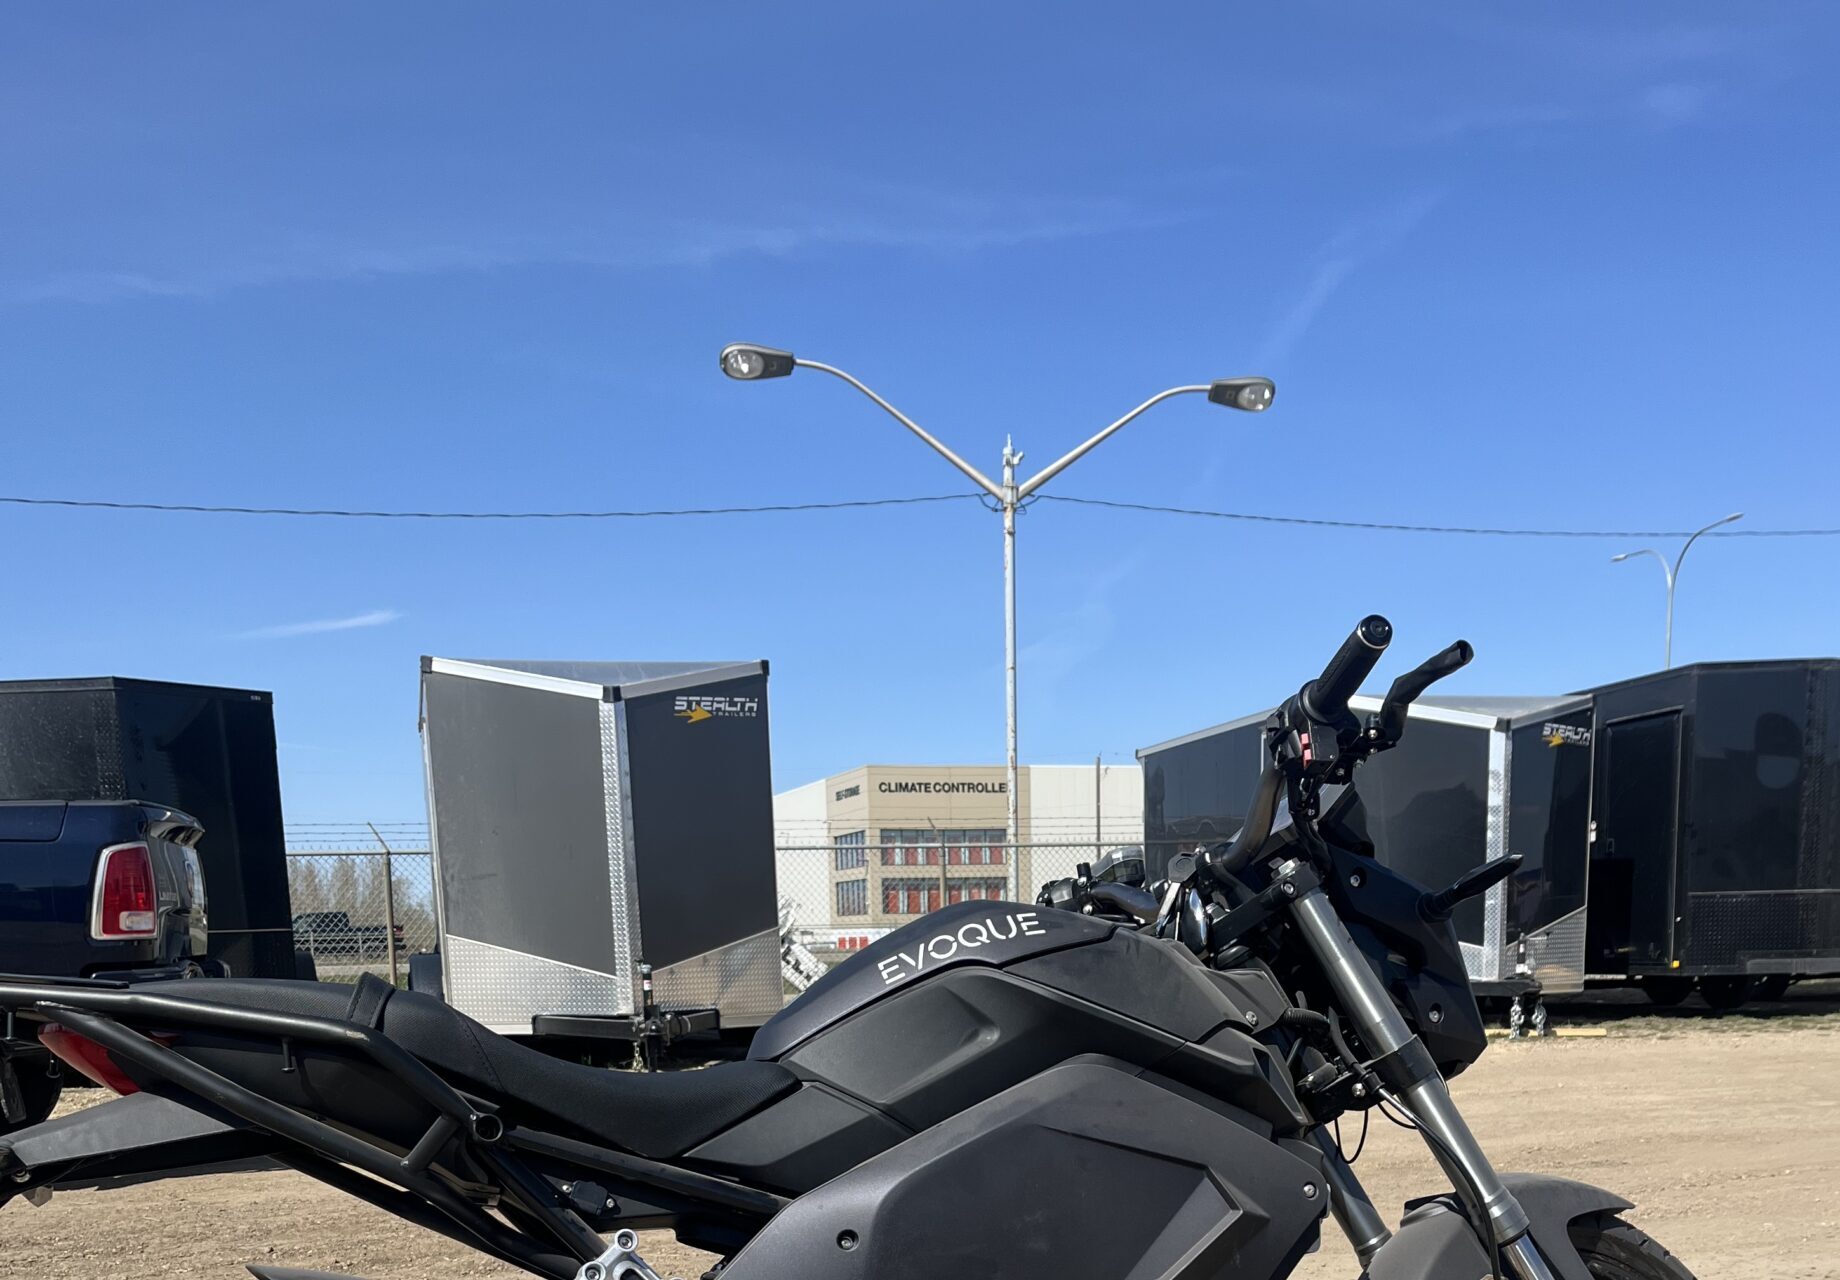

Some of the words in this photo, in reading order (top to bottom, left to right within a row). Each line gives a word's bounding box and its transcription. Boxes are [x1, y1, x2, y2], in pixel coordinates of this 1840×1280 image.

[674, 696, 758, 712] STEALTH
[1542, 722, 1592, 742] STEALTH
[878, 782, 931, 794] CLIMATE
[933, 782, 1008, 794] CONTROLLE
[877, 912, 1046, 985] EVOQUE
